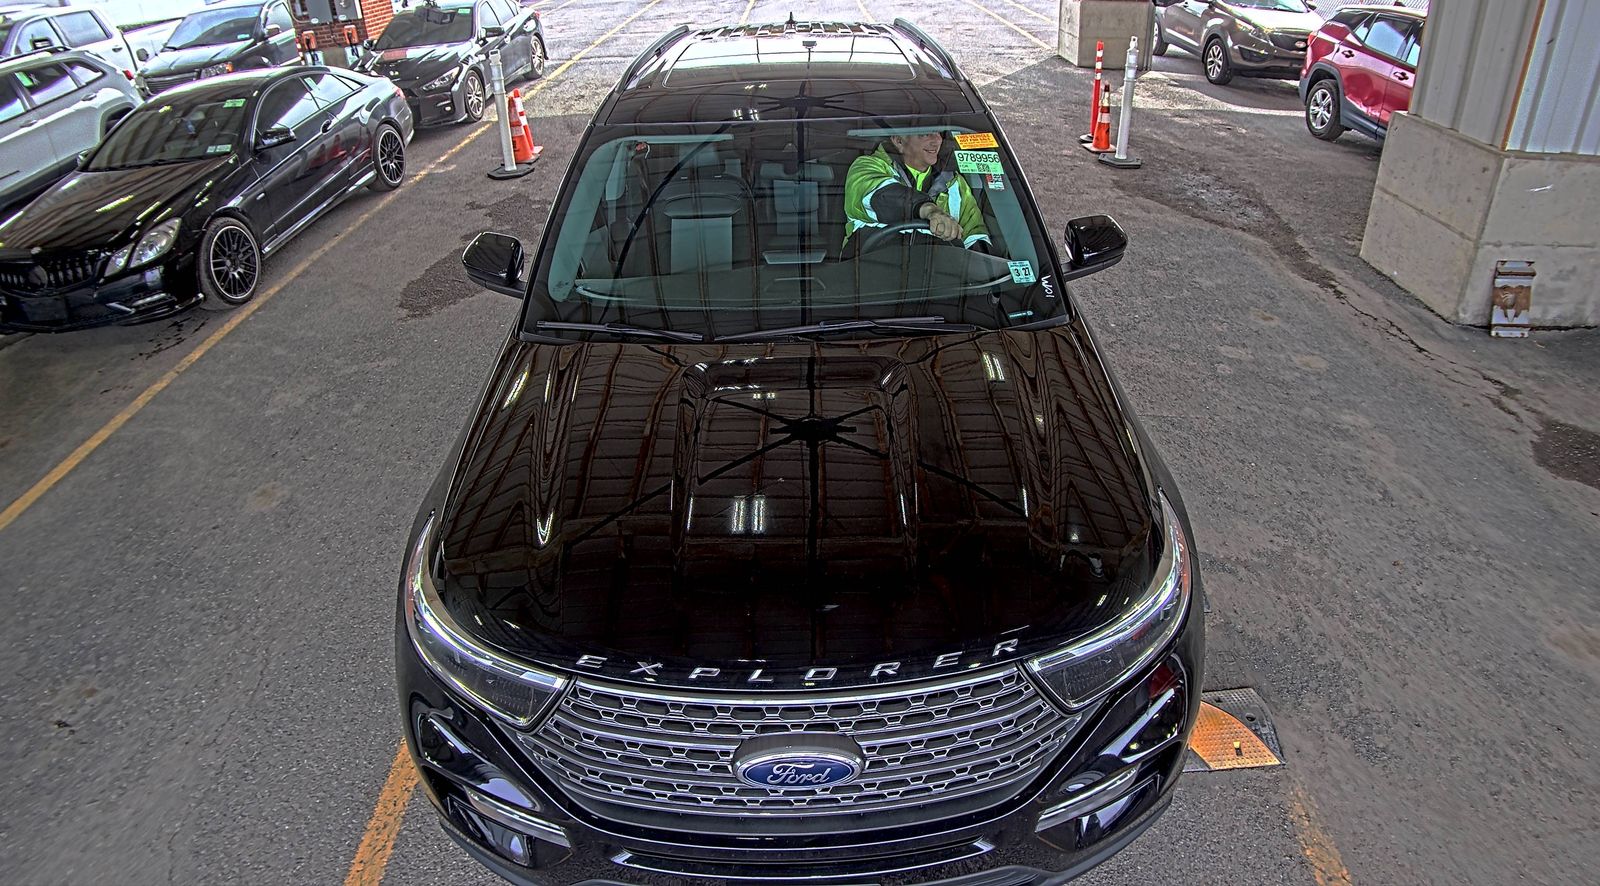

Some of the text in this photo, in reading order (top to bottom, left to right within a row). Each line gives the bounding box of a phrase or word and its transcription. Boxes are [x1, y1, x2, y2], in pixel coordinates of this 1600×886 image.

[957, 152, 1000, 164] 9789956
[1014, 267, 1031, 277] 3 27
[575, 638, 1019, 682] EXPLORER
[766, 762, 831, 785] Ford
